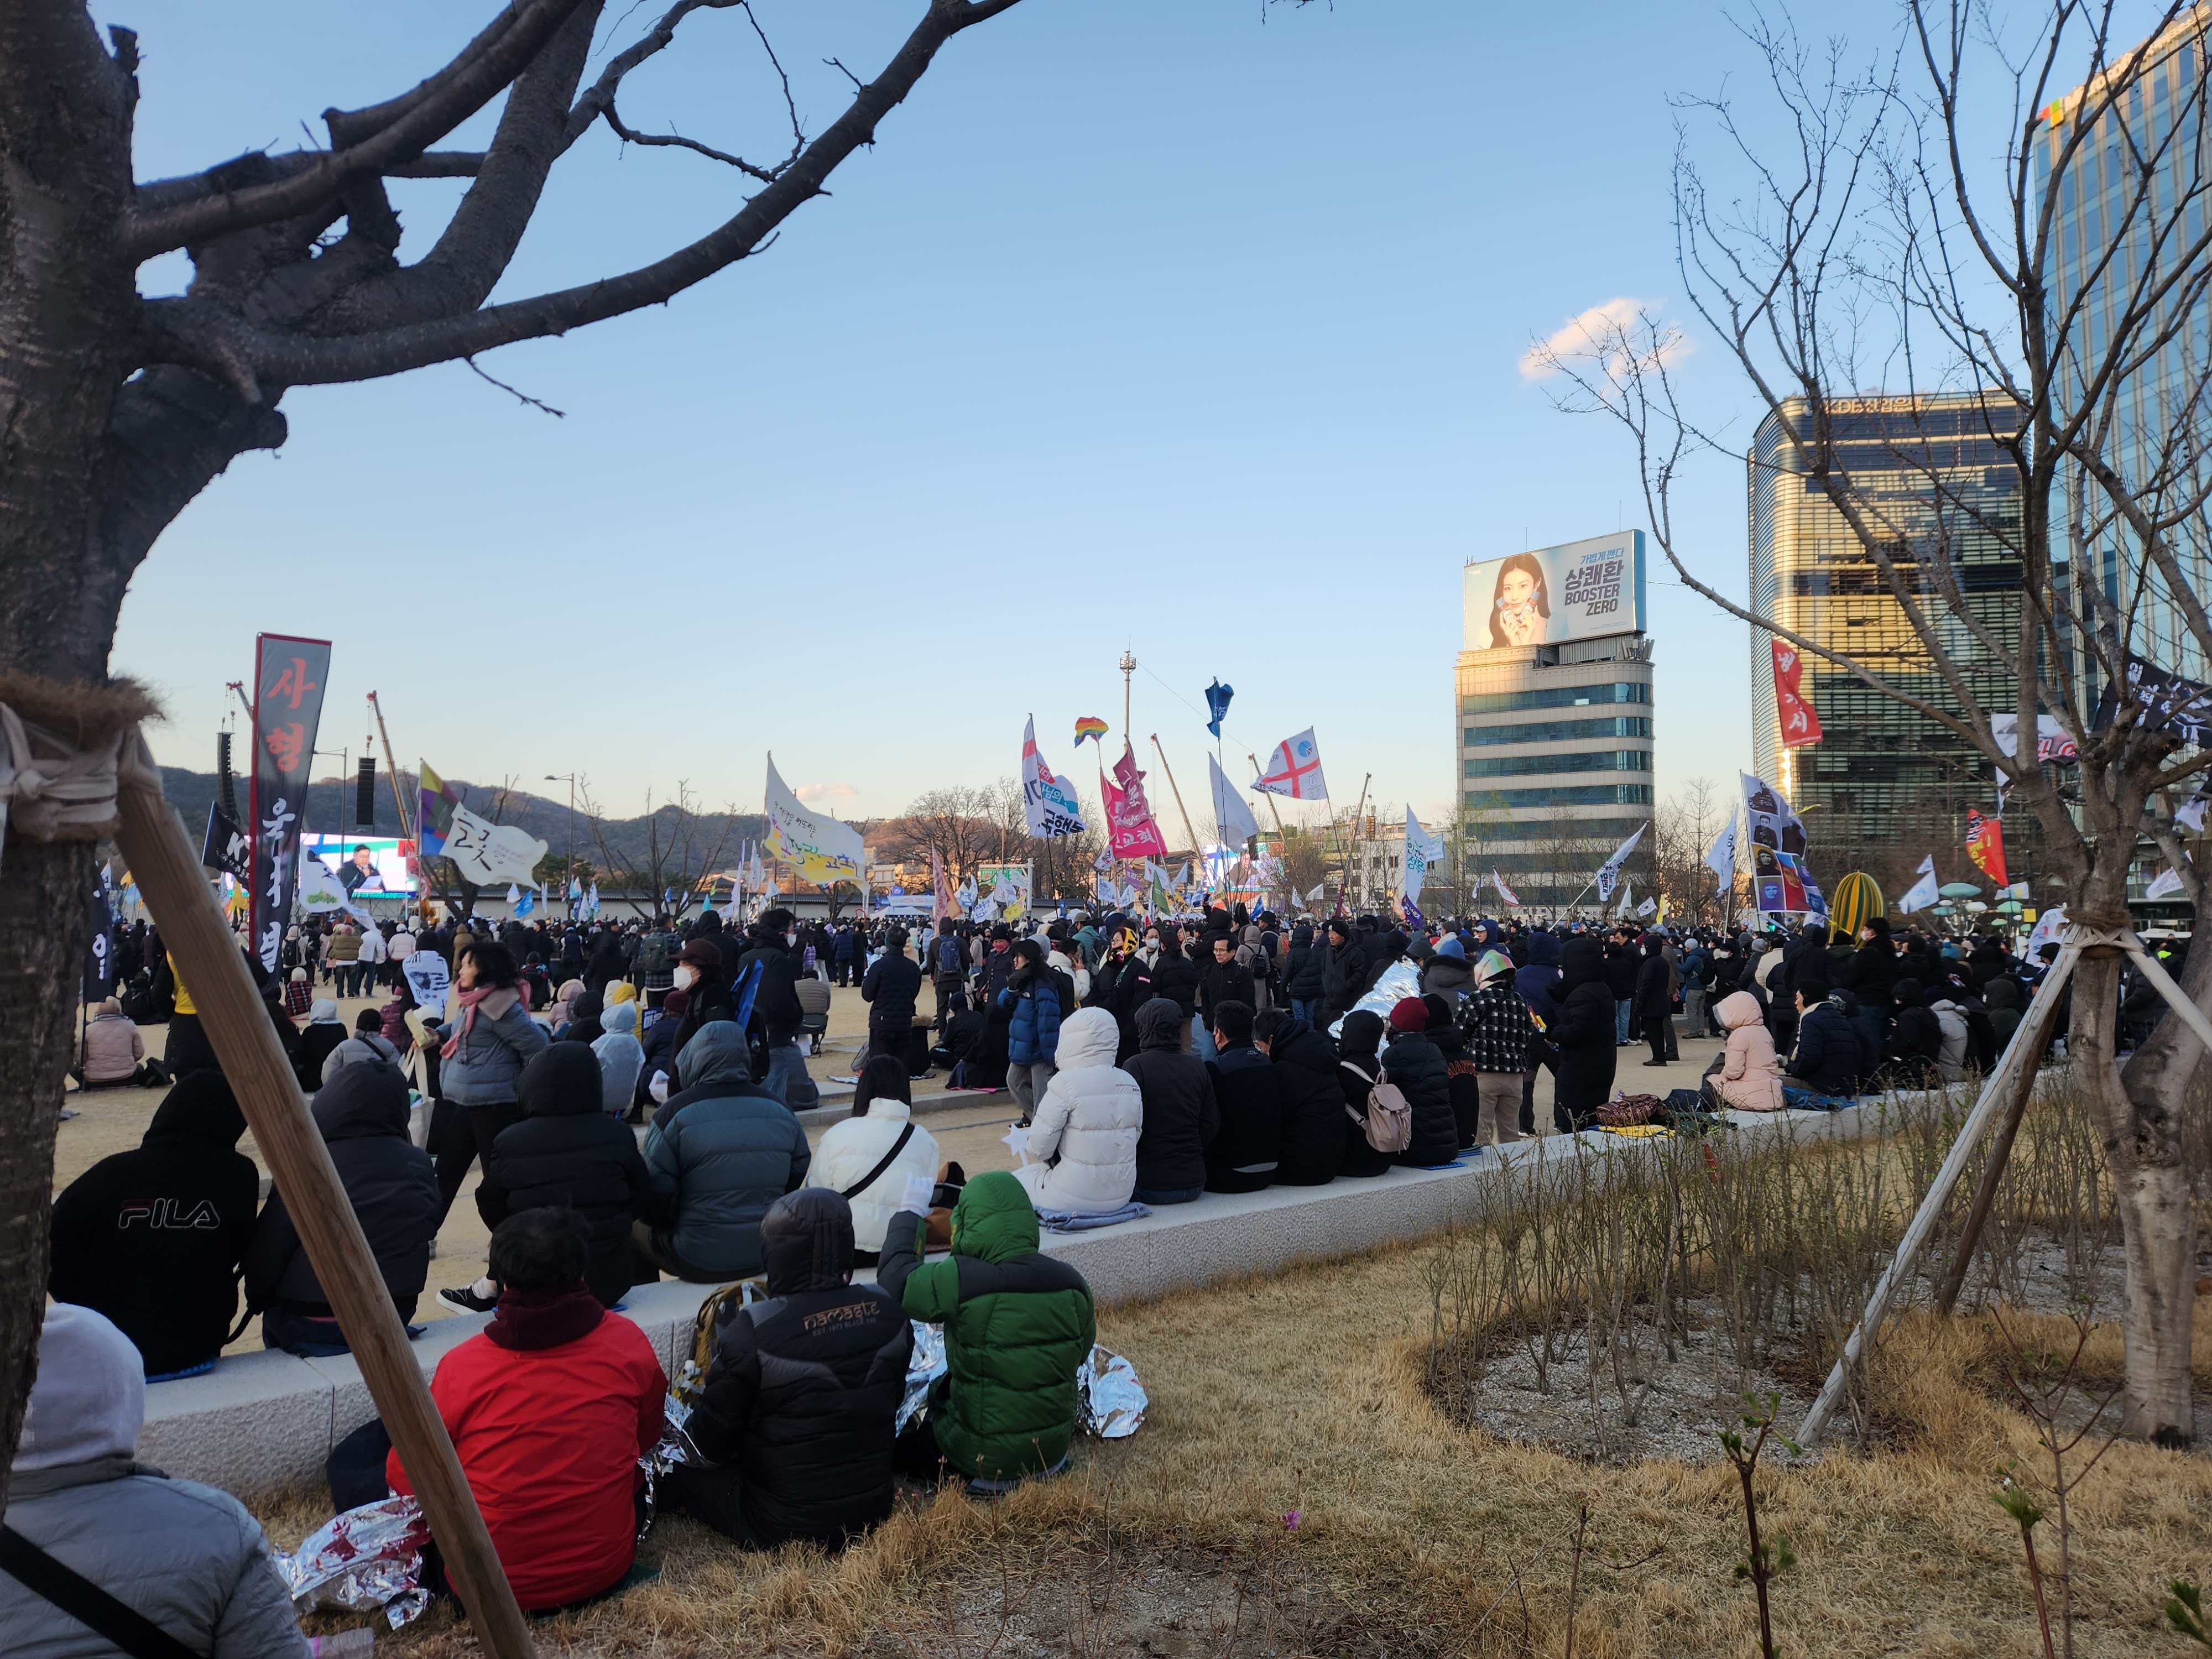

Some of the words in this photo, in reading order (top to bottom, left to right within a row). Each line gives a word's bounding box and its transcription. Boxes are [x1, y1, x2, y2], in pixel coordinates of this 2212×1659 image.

[1580, 549, 1605, 565] 가볍게
[1606, 547, 1625, 561] 깬다
[1564, 559, 1624, 591] 상쾌환
[1564, 583, 1620, 606] BOOSTER
[1585, 598, 1619, 617] ZERO
[266, 657, 316, 772] 사형
[118, 1198, 220, 1229] FILA
